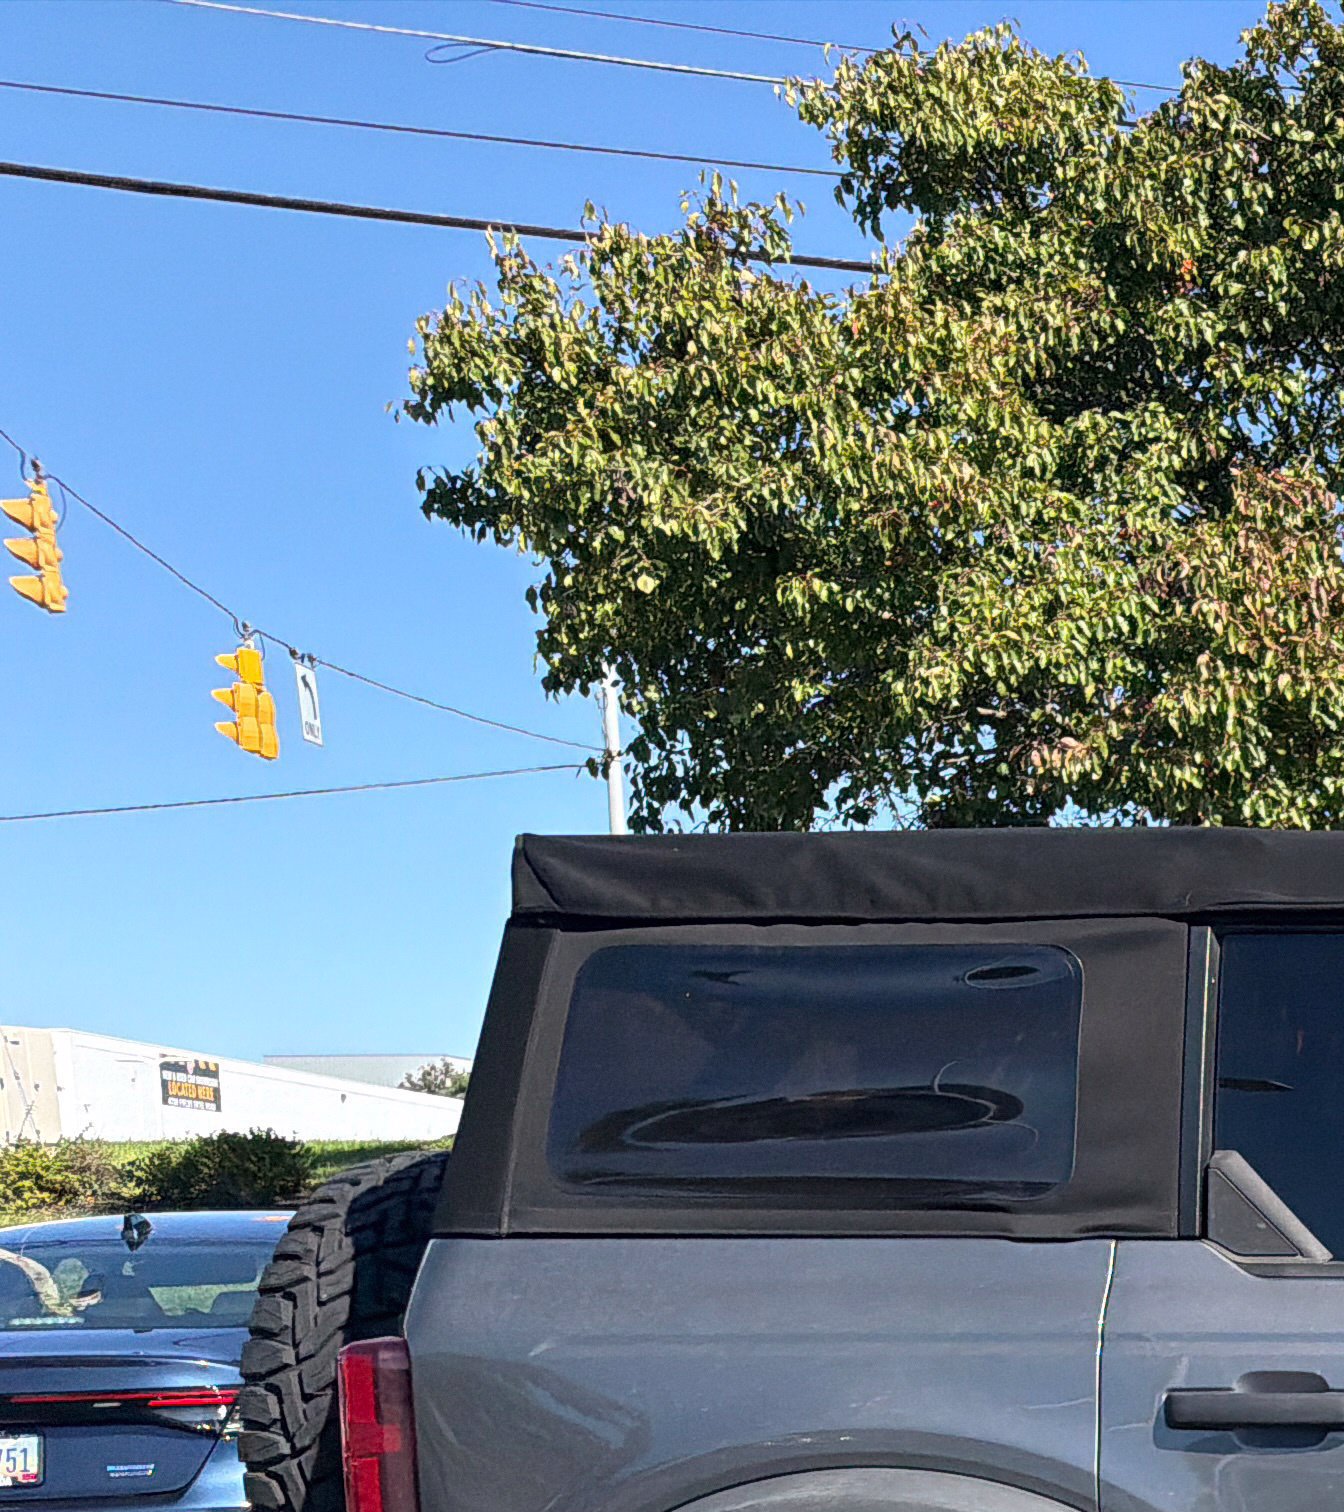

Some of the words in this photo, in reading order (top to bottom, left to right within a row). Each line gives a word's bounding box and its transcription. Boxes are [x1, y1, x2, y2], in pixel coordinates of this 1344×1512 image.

[305, 720, 320, 739] ONLY
[168, 1080, 197, 1099] LOCATED
[0, 1448, 31, 1473] 51
